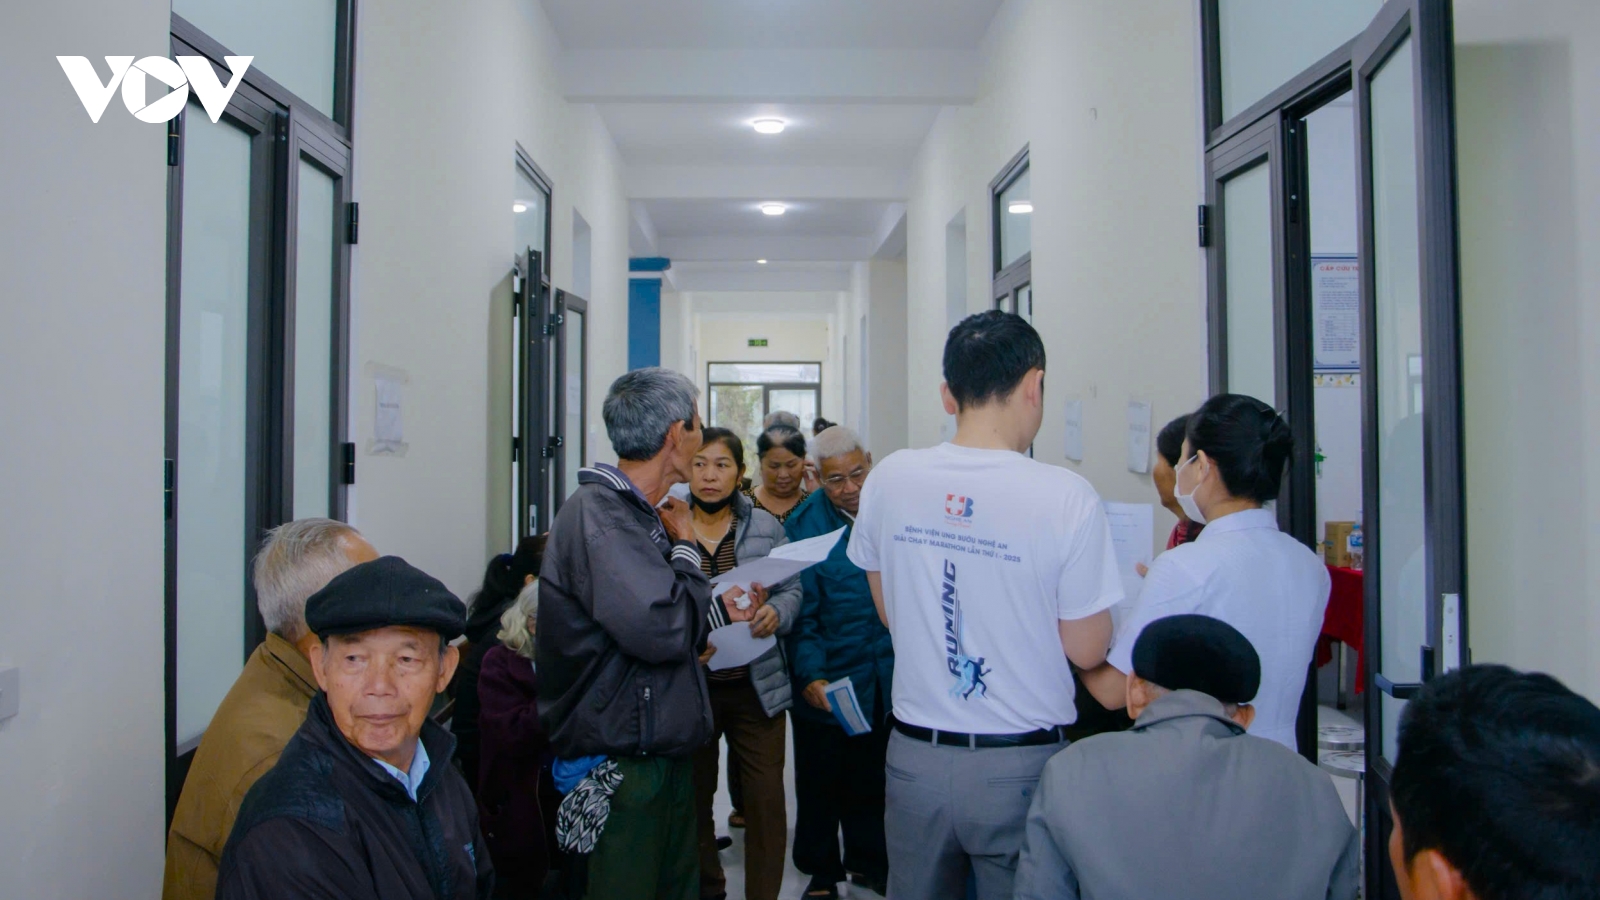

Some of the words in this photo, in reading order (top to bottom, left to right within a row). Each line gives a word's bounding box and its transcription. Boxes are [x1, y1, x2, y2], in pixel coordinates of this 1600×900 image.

[893, 534, 907, 542] GIẢI
[929, 539, 966, 552] MARATHON
[967, 545, 981, 555] LẦN
[982, 548, 995, 558] THỨ
[1003, 553, 1021, 563] 2025
[904, 525, 923, 534] BỆNH
[925, 528, 940, 537] VIỆN
[941, 531, 956, 540] UNG
[978, 538, 996, 548] NGHỆ
